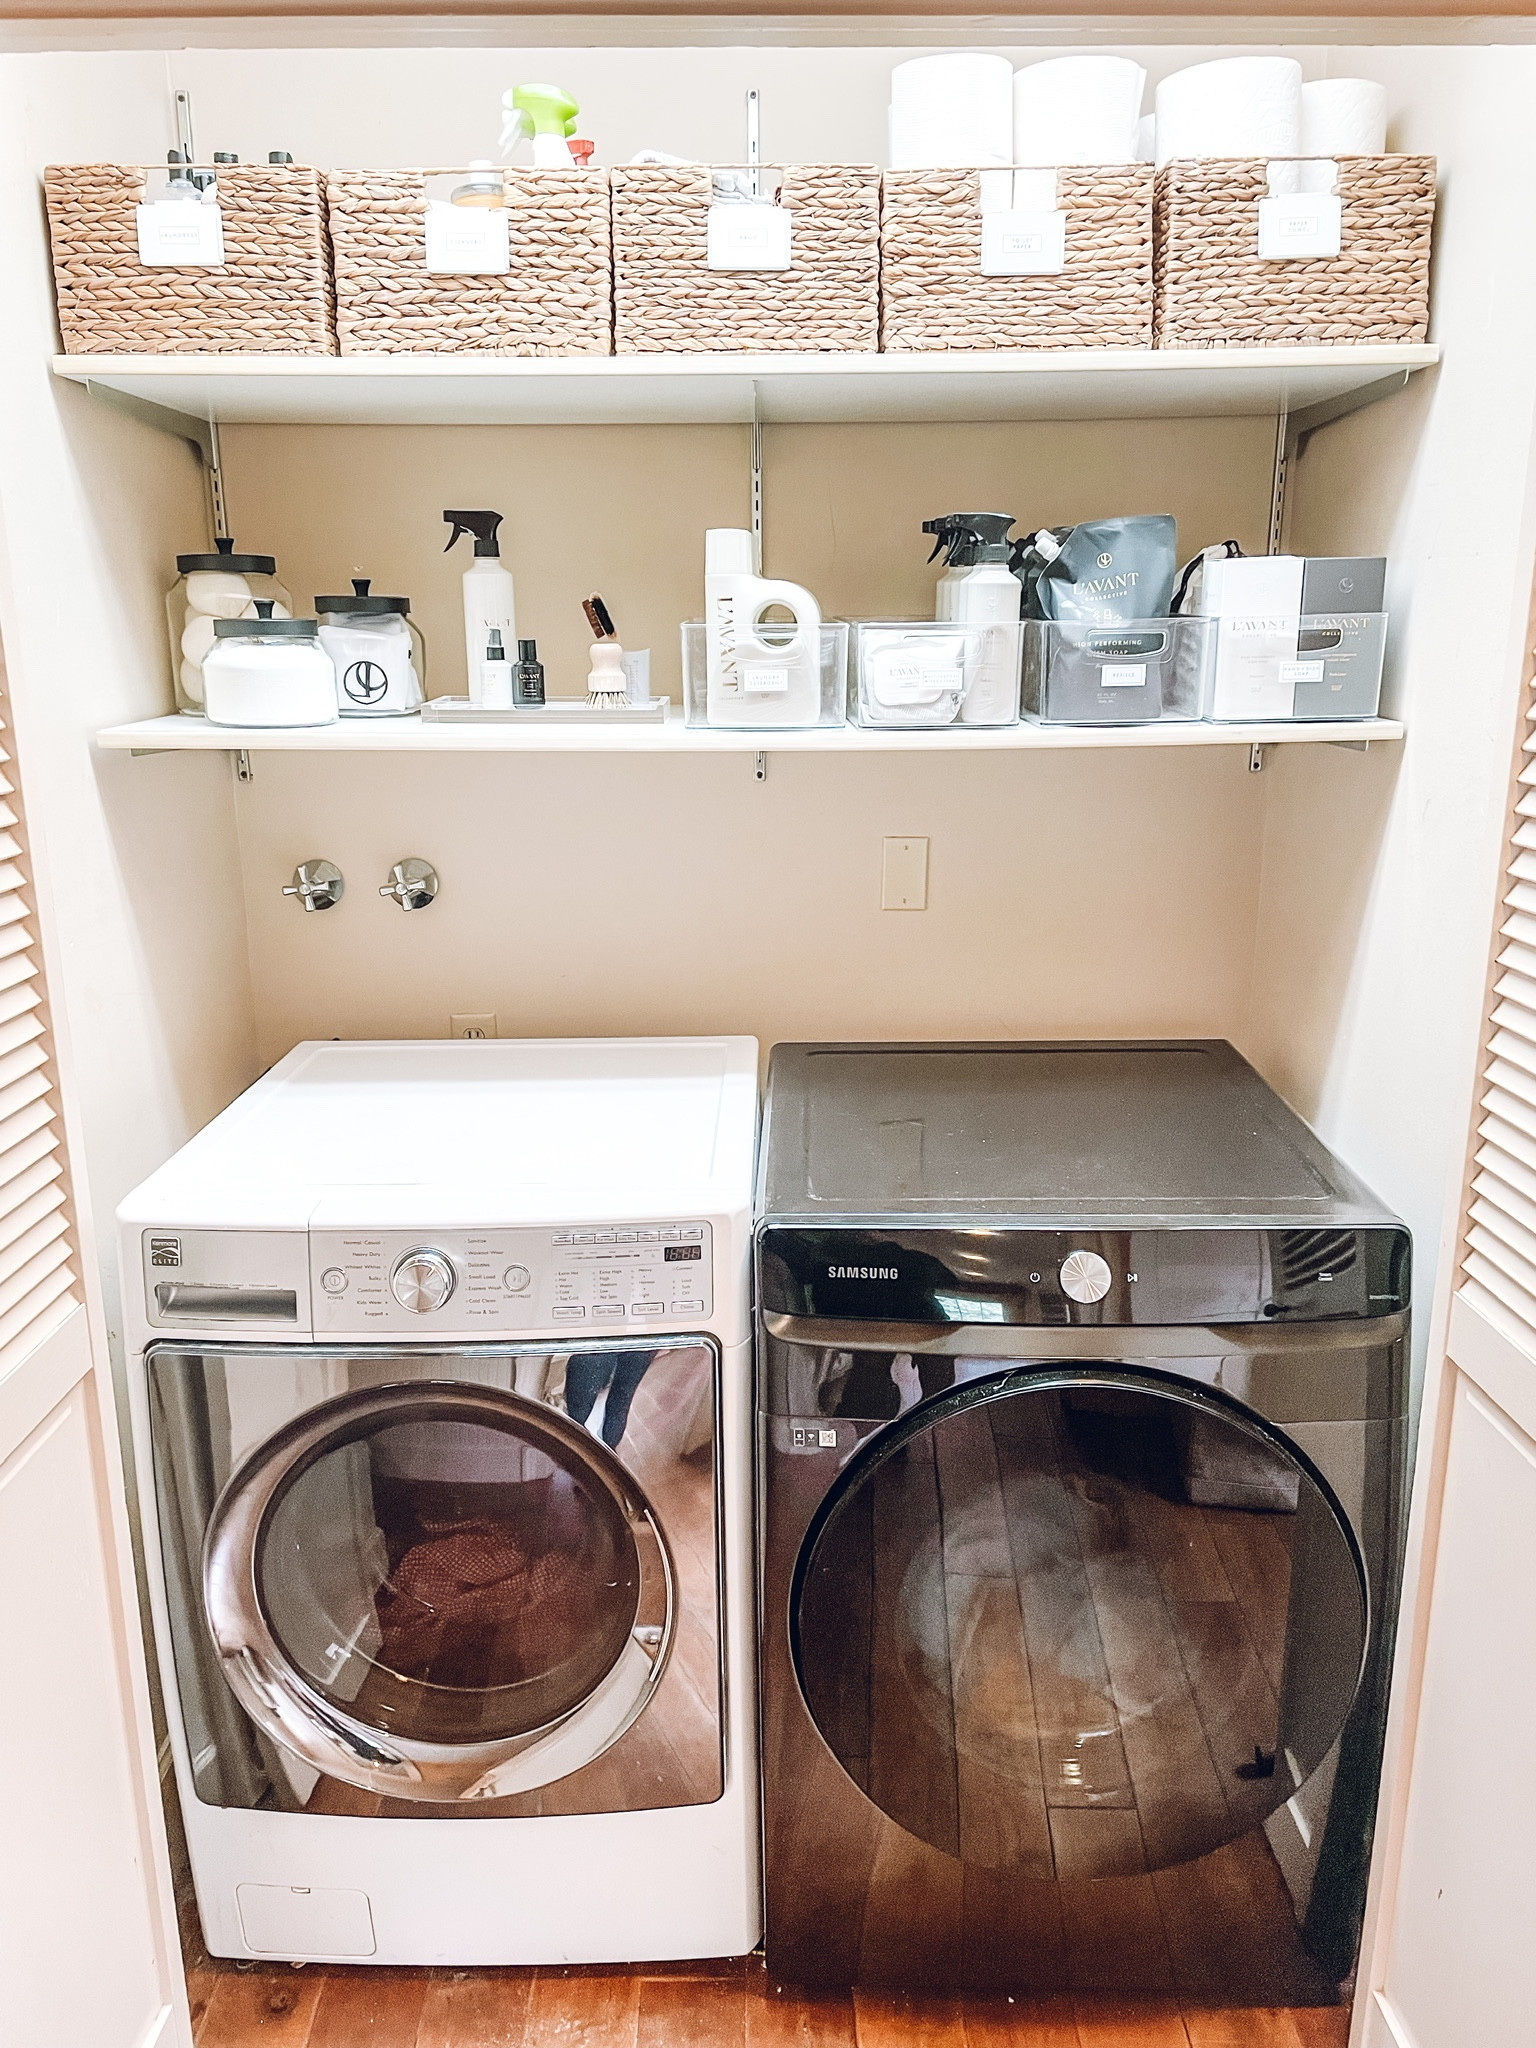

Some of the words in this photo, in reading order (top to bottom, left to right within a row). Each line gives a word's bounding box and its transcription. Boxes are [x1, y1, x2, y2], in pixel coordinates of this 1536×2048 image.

[1072, 572, 1140, 597] L'AVANT
[1232, 619, 1288, 632] L'AVANT
[1312, 616, 1371, 630] L'AVANT
[716, 597, 740, 692] L'AVANT
[1094, 638, 1143, 648] PERFORMING
[153, 1257, 179, 1265] ELITE
[827, 1265, 899, 1281] SAMSUNG
